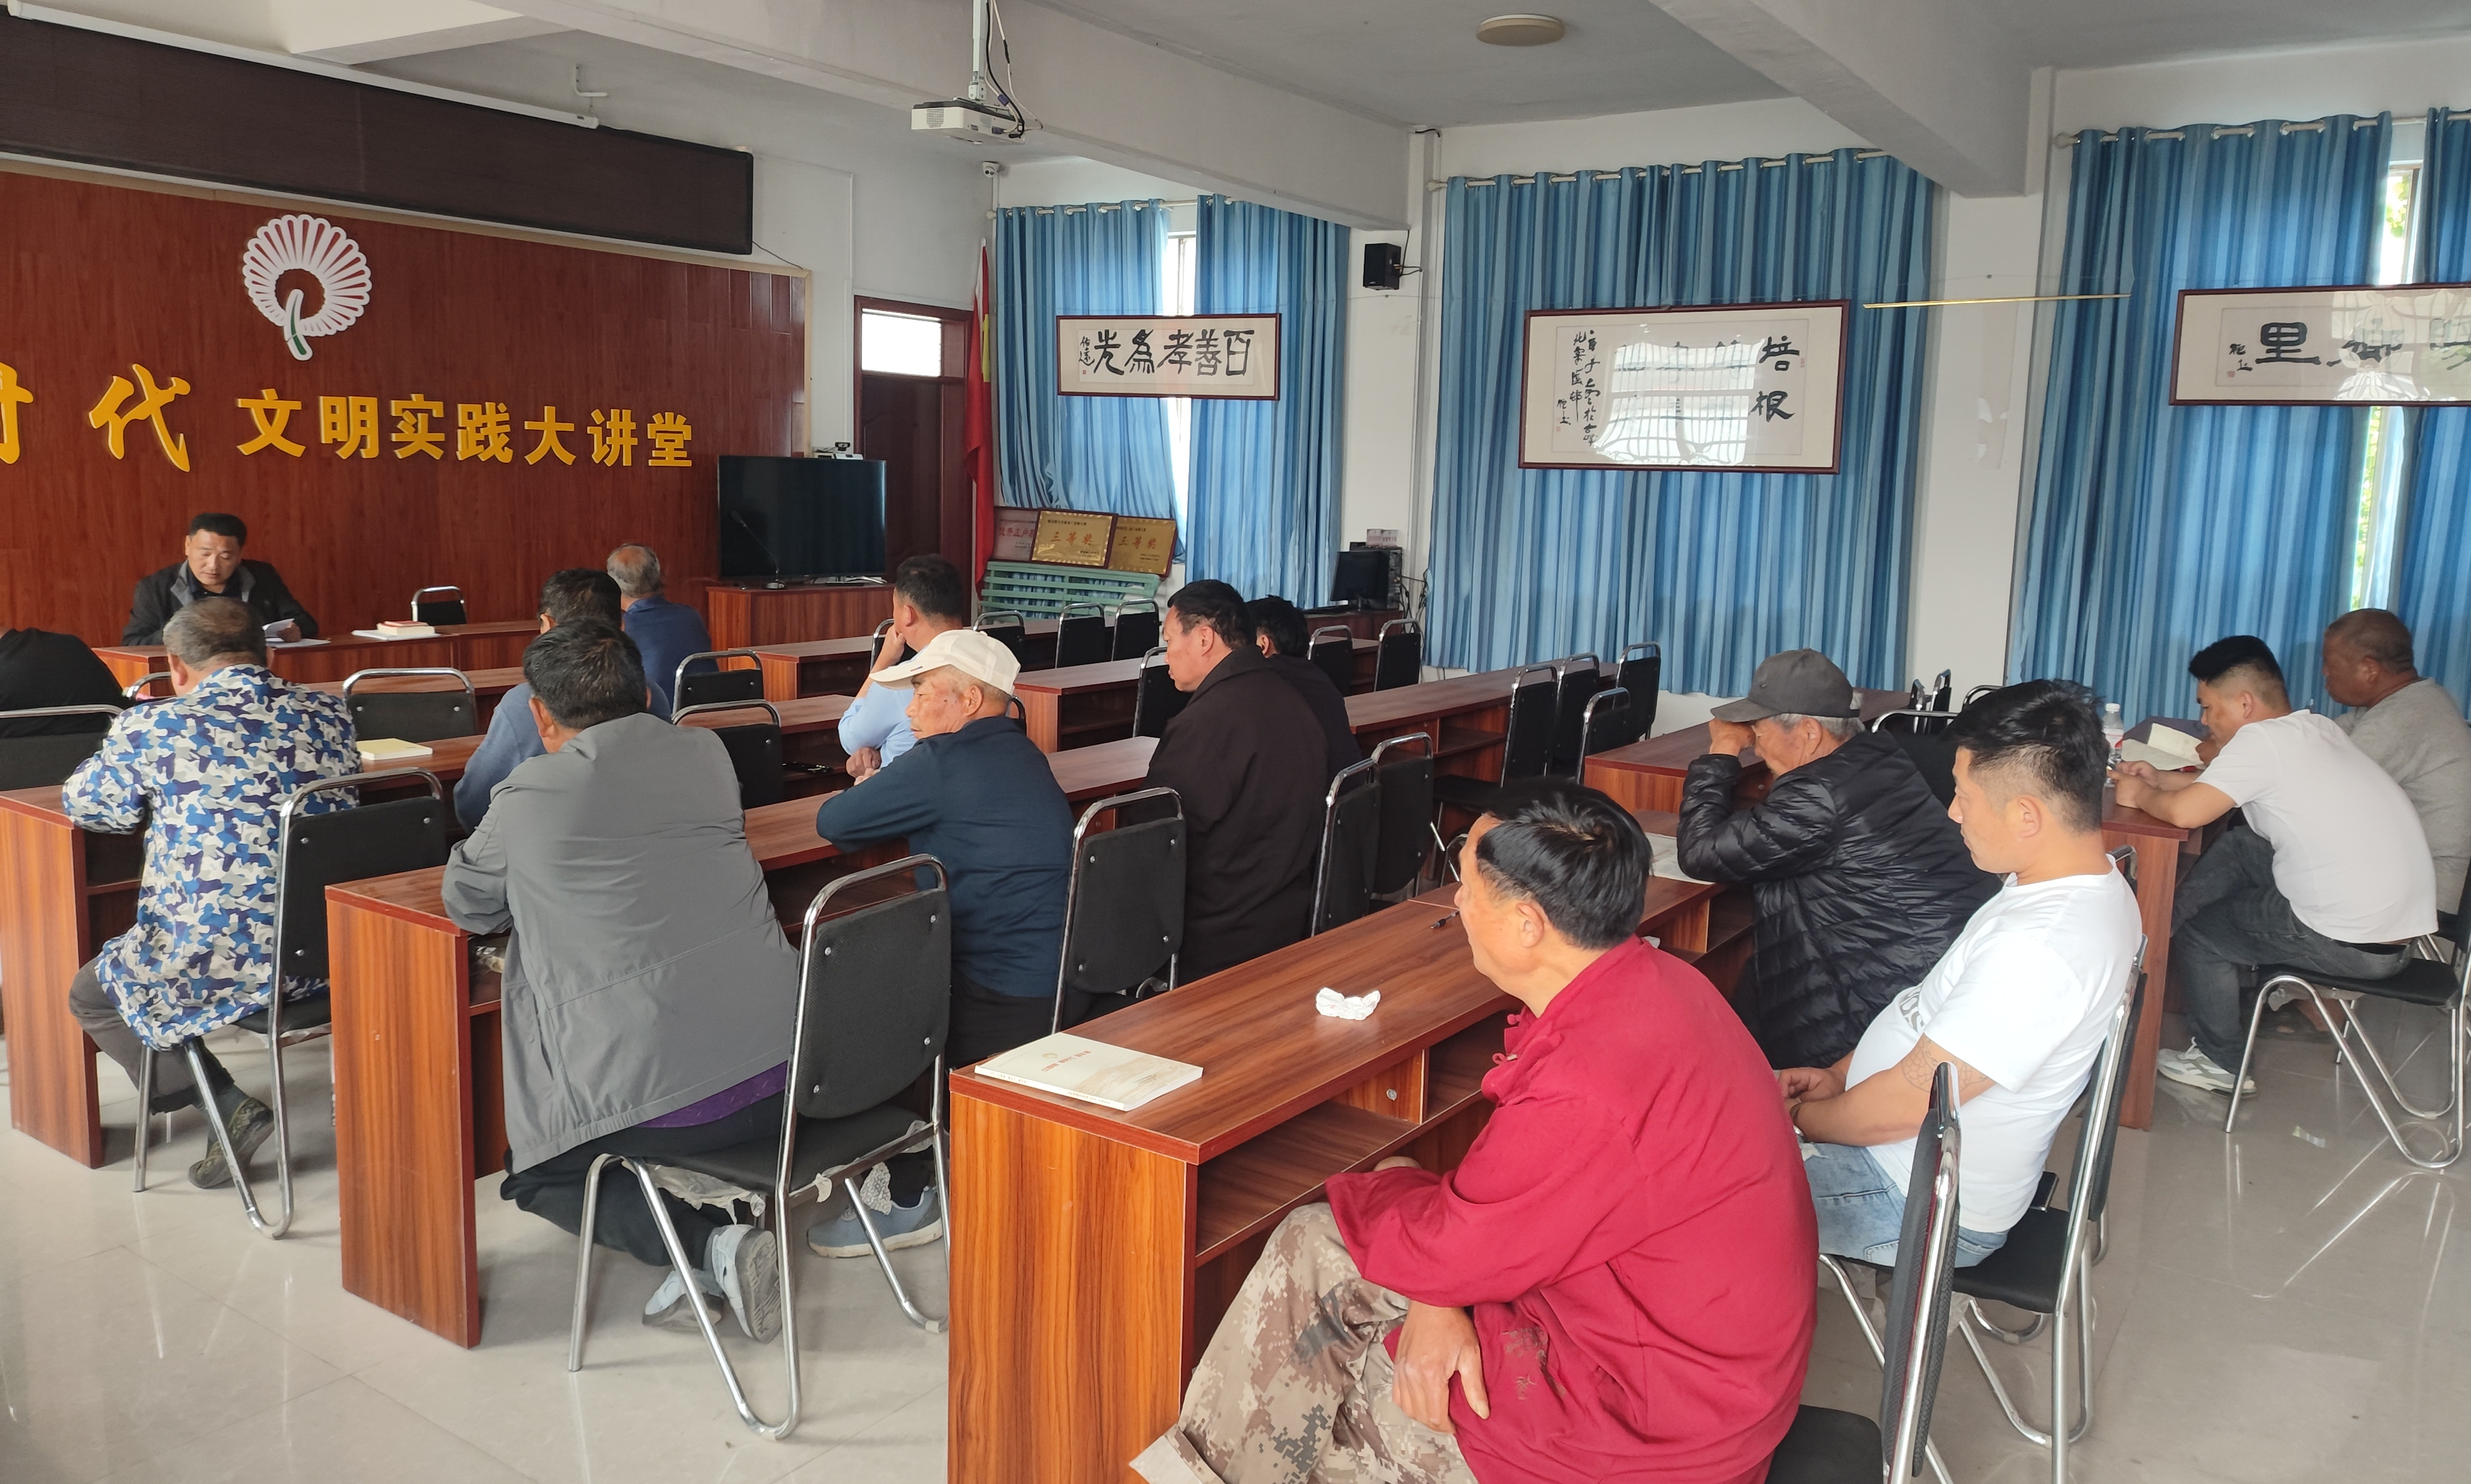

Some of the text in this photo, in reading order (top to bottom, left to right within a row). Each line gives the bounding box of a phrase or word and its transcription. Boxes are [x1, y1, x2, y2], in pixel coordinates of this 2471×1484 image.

[236, 388, 692, 468] 文明实践大讲堂
[1051, 530, 1093, 546] 三等奖
[1118, 536, 1157, 550] 三等奖
